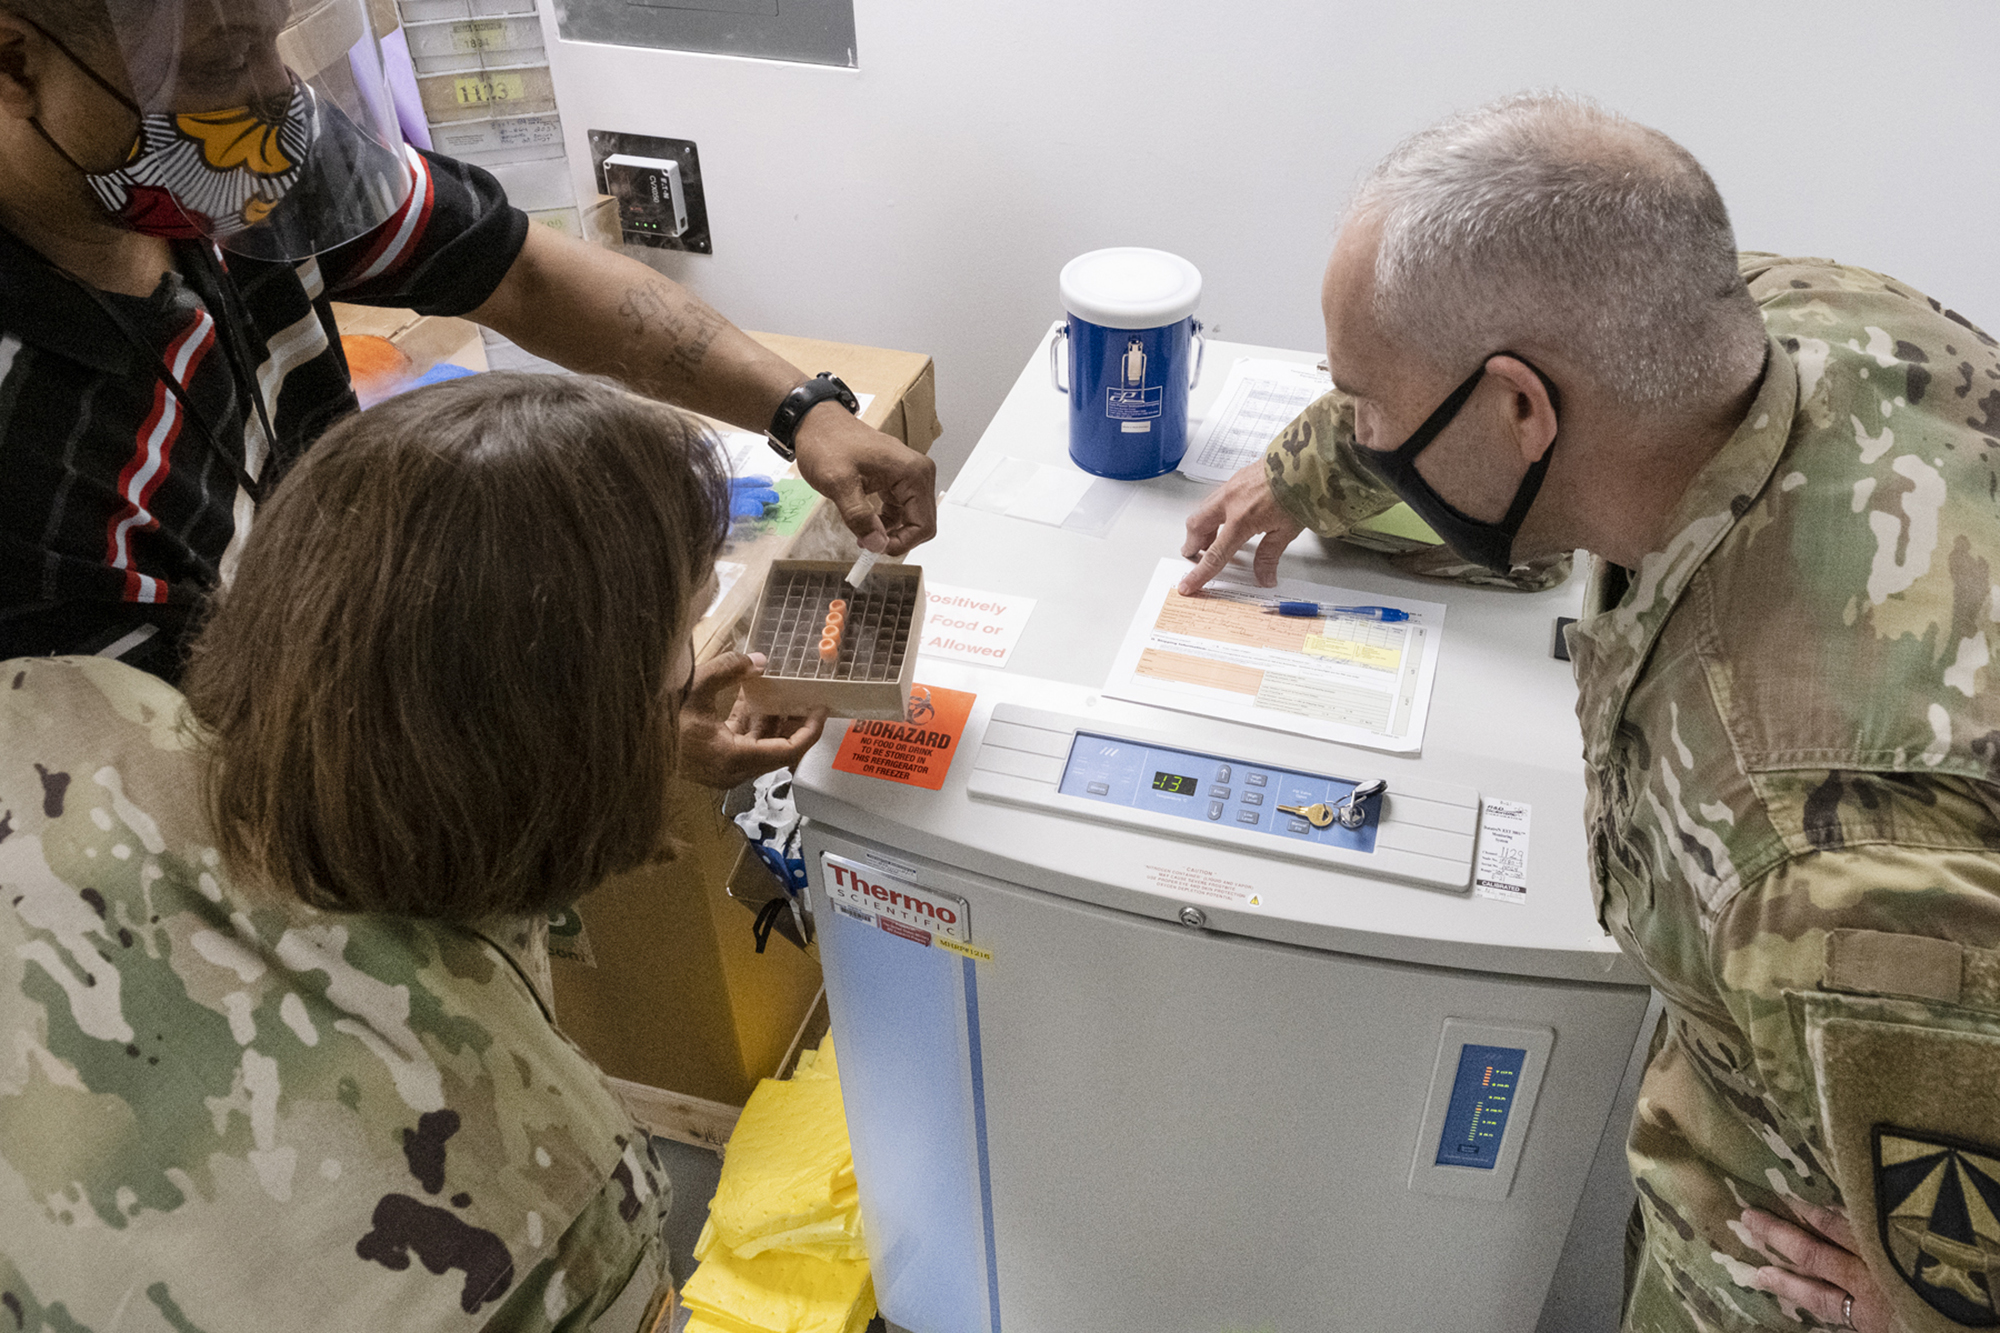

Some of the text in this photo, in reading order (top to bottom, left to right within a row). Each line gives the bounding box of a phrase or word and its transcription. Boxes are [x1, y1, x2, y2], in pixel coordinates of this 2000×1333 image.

[460, 83, 508, 102] 1123
[929, 614, 1004, 635] Food or
[927, 636, 1006, 658] Allowed
[852, 719, 951, 749] BIOHAZARD
[860, 737, 933, 757] NO FOOD OR DRINK
[861, 746, 927, 764] TO BE STORED IN
[852, 753, 928, 774] THIS REFRIGERATOR
[863, 764, 910, 780] OR FREEZER
[827, 862, 957, 924] Thermo
[1481, 880, 1521, 893] CALIBRATED
[837, 889, 955, 936] SCIENTIFIC
